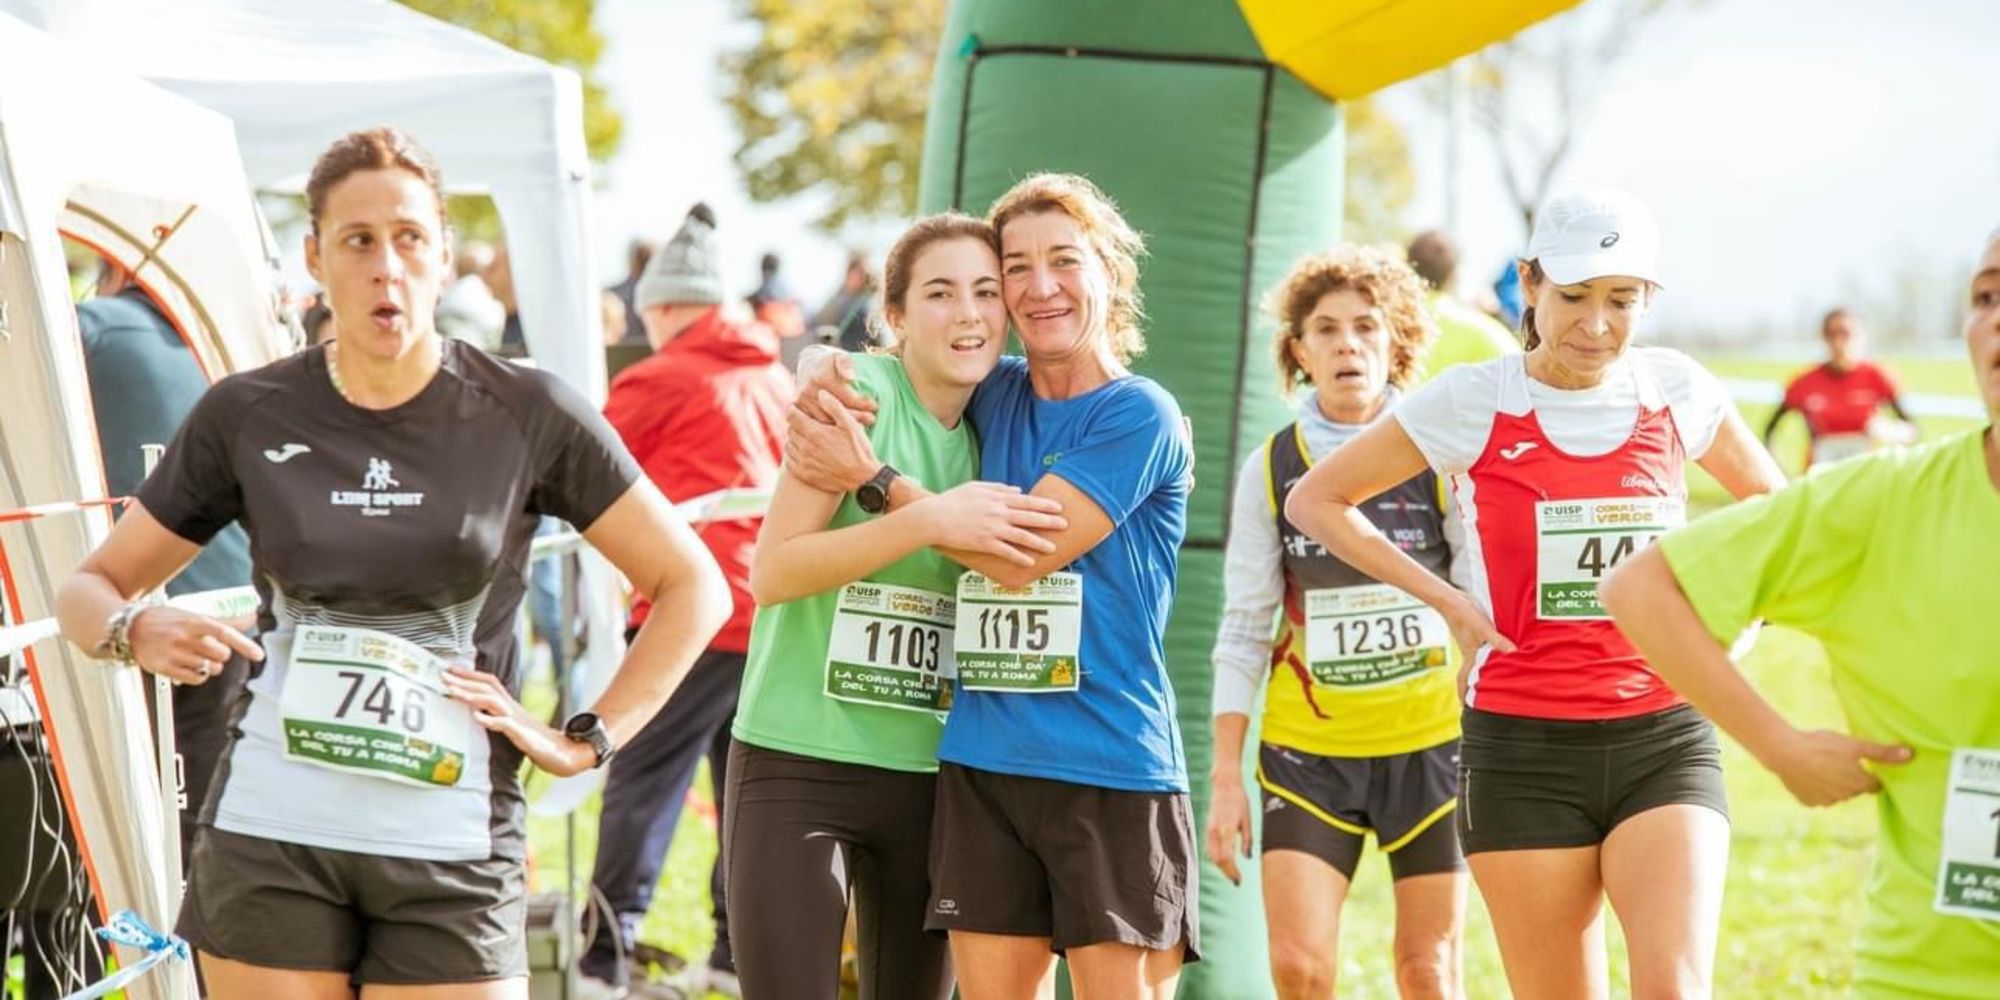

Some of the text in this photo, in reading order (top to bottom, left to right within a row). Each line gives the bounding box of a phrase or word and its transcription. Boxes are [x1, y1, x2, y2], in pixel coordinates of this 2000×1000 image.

[1554, 505, 1583, 515] UISP
[1577, 535, 1658, 578] 44
[1050, 577, 1077, 587] UISP
[856, 586, 881, 597] UISP
[1547, 590, 1599, 599] LA COR
[978, 608, 1051, 651] 1115
[1333, 614, 1423, 656] 1236
[865, 621, 941, 672] 1103
[971, 659, 997, 669] CORSA
[835, 670, 852, 680] LA
[857, 673, 899, 687] CORSA
[991, 672, 999, 680] A
[1002, 671, 1038, 681] ROMA
[873, 685, 889, 696] TU
[892, 687, 902, 697] A
[905, 689, 932, 701] ROMA
[335, 671, 426, 734] 746
[288, 727, 310, 739] LA
[313, 730, 367, 747] CORSA
[332, 745, 353, 758] TU
[355, 748, 370, 760] A
[373, 750, 421, 772] ROMA
[1952, 871, 1978, 887] LA
